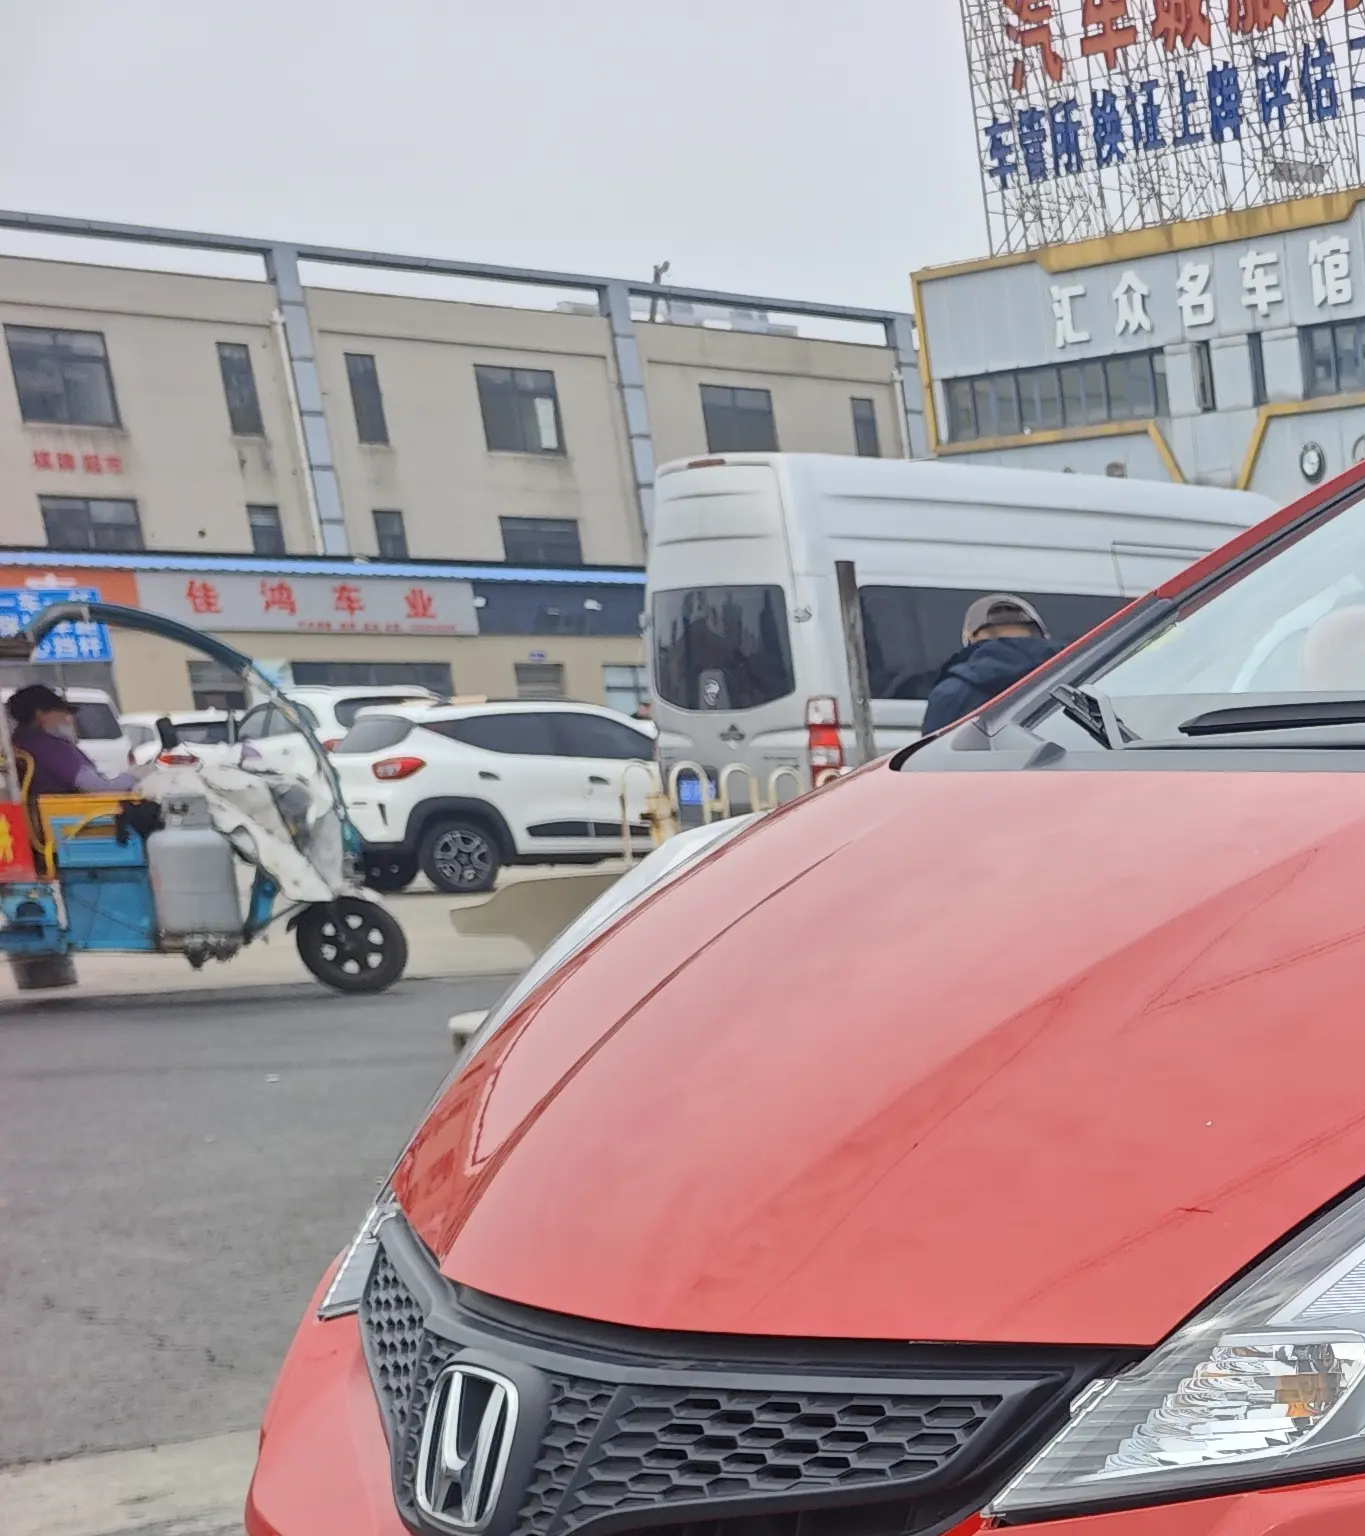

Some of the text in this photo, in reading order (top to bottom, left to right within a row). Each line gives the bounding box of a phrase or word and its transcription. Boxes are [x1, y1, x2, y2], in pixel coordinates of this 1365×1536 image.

[1048, 234, 1355, 349] 汇众名车馆
[186, 579, 438, 619] 佳鸿车业
